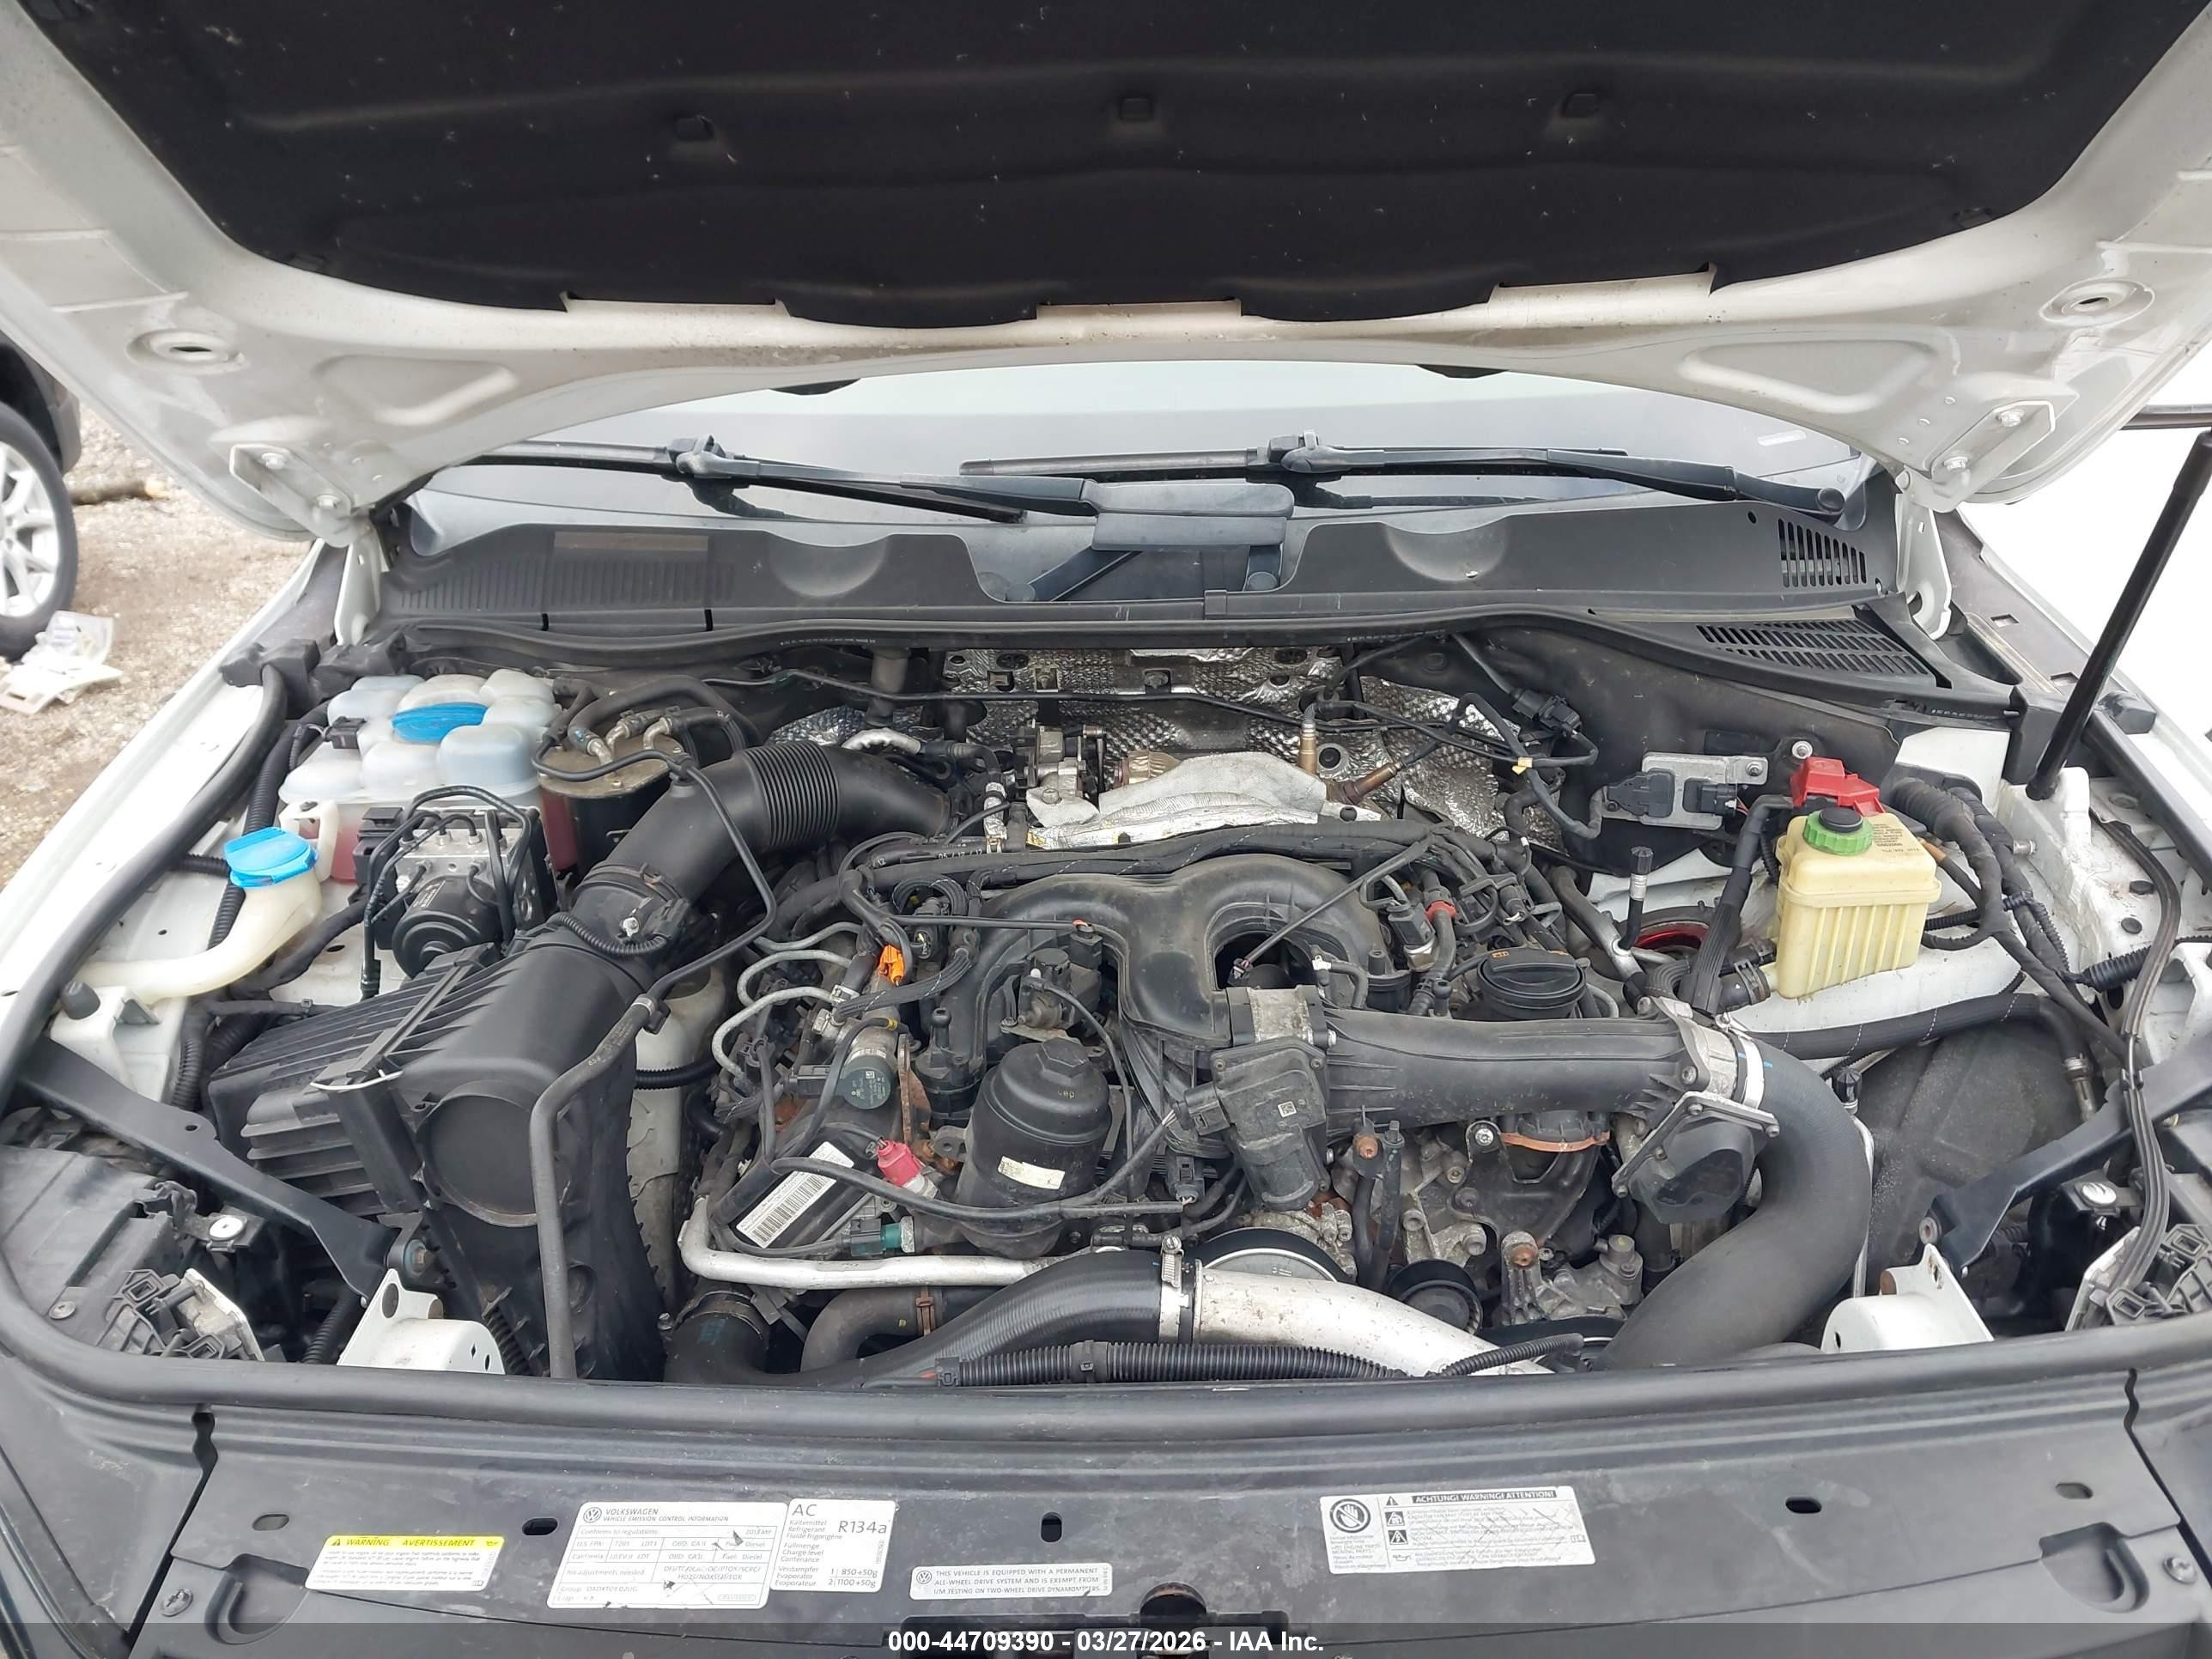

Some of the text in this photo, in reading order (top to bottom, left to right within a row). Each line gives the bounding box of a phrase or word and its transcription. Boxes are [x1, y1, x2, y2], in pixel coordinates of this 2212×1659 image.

[1415, 1490, 1555, 1504] ACHTUNG! WARNING! ATTENTION!
[792, 1504, 817, 1516] AC
[838, 1521, 887, 1534] R134a
